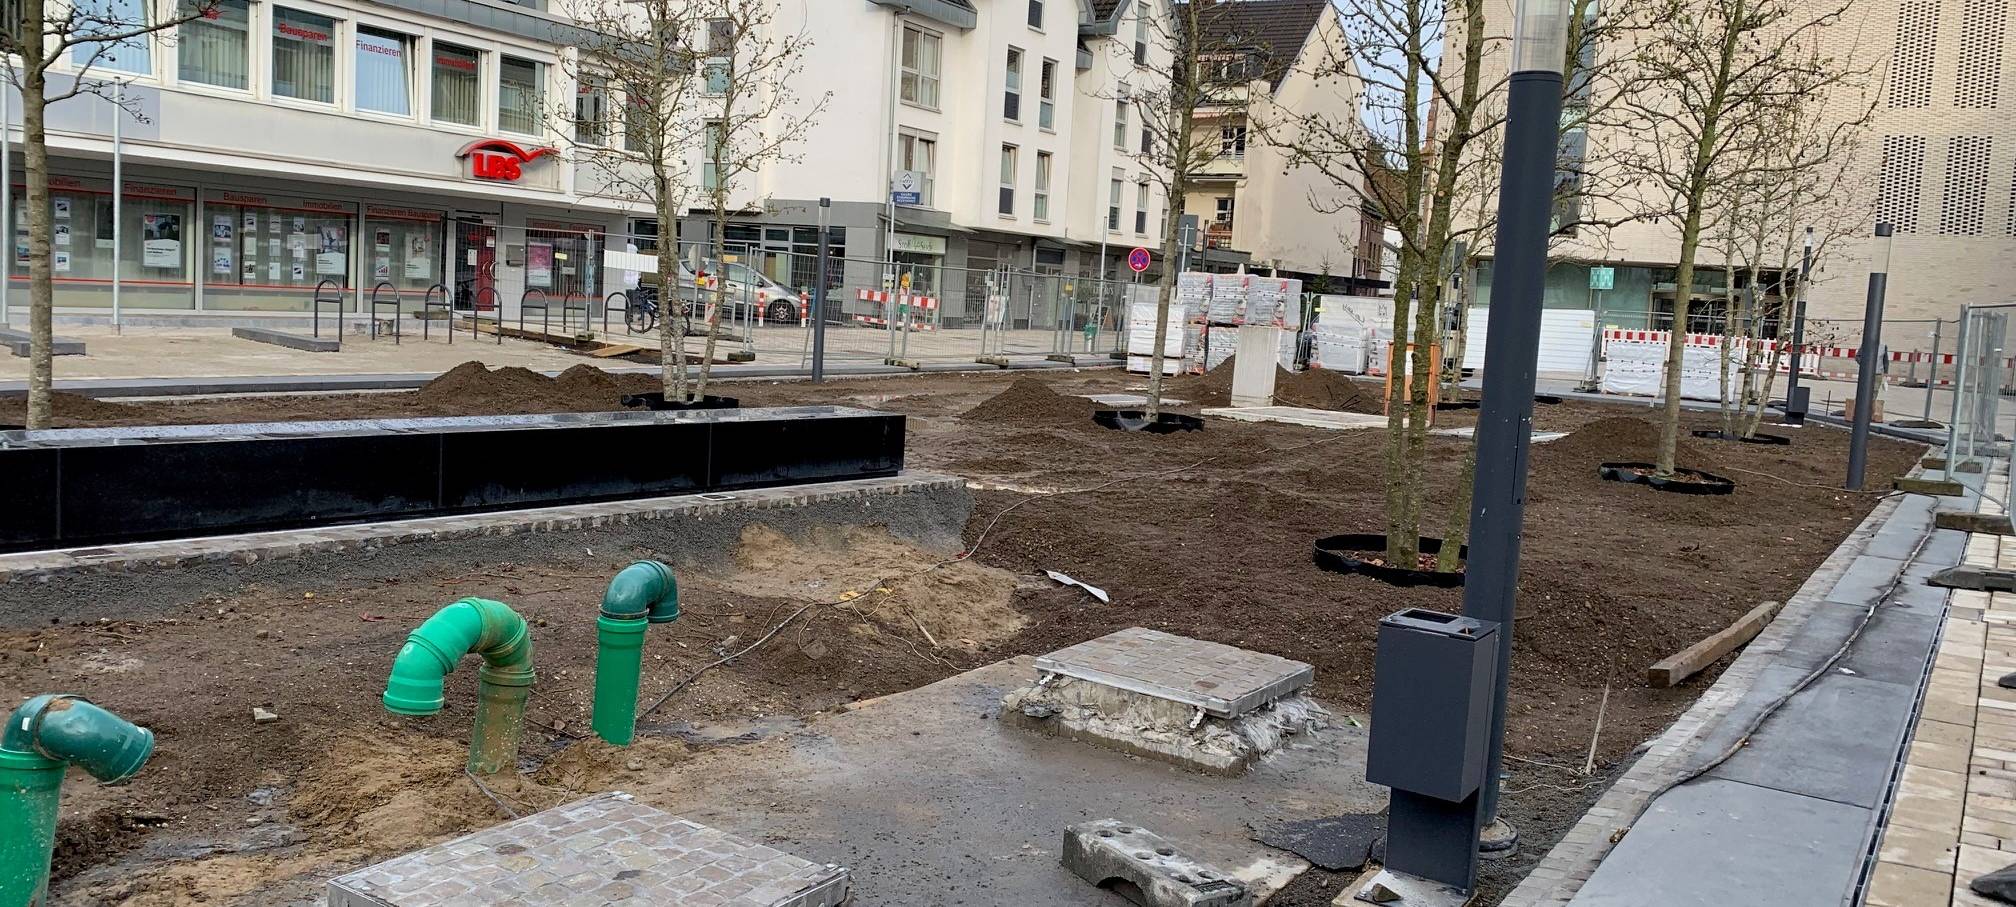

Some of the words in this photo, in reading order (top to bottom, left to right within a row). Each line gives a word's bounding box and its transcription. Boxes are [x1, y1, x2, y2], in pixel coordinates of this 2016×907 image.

[278, 22, 328, 42] Bausparen
[355, 39, 401, 58] Finanzieren
[472, 152, 522, 181] LBS
[223, 191, 268, 206] Bausparen
[303, 200, 343, 211] Immobilien
